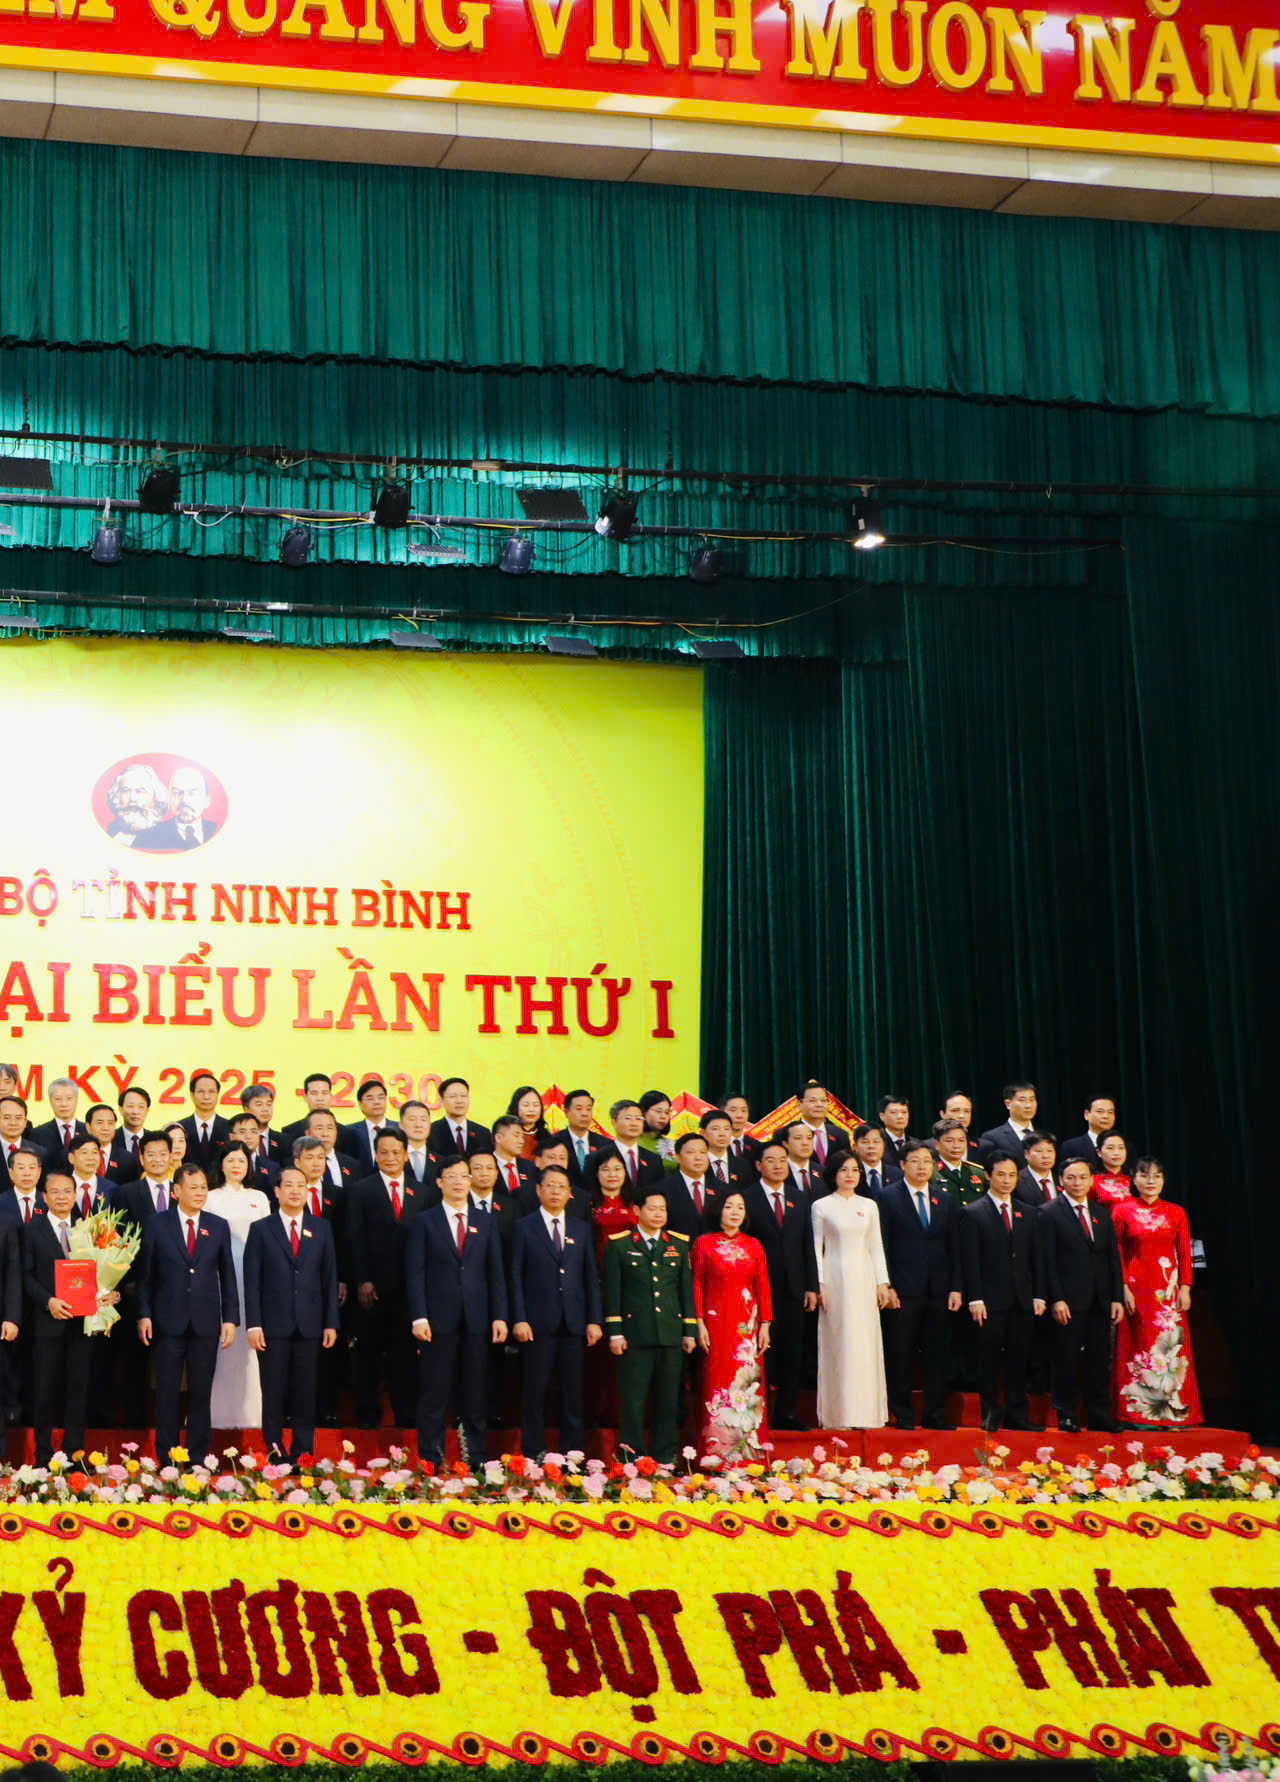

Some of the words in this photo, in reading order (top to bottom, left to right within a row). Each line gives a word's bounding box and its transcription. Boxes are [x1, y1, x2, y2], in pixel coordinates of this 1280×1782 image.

[525, 0, 762, 74] VINH
[72, 867, 198, 922] TỈNH
[211, 883, 339, 926] NINH
[351, 880, 472, 931] BÌNH
[92, 941, 272, 1028] BIỂU
[292, 947, 445, 1033] LẦN
[465, 963, 632, 1037] THỨ
[650, 979, 676, 1039] I
[68, 1054, 139, 1103] KỲ
[127, 1578, 441, 1700] CƯƠNG
[524, 1567, 703, 1723] ĐỘT
[713, 1569, 920, 1698] PHÁ
[979, 1568, 1212, 1689] PHÁT
